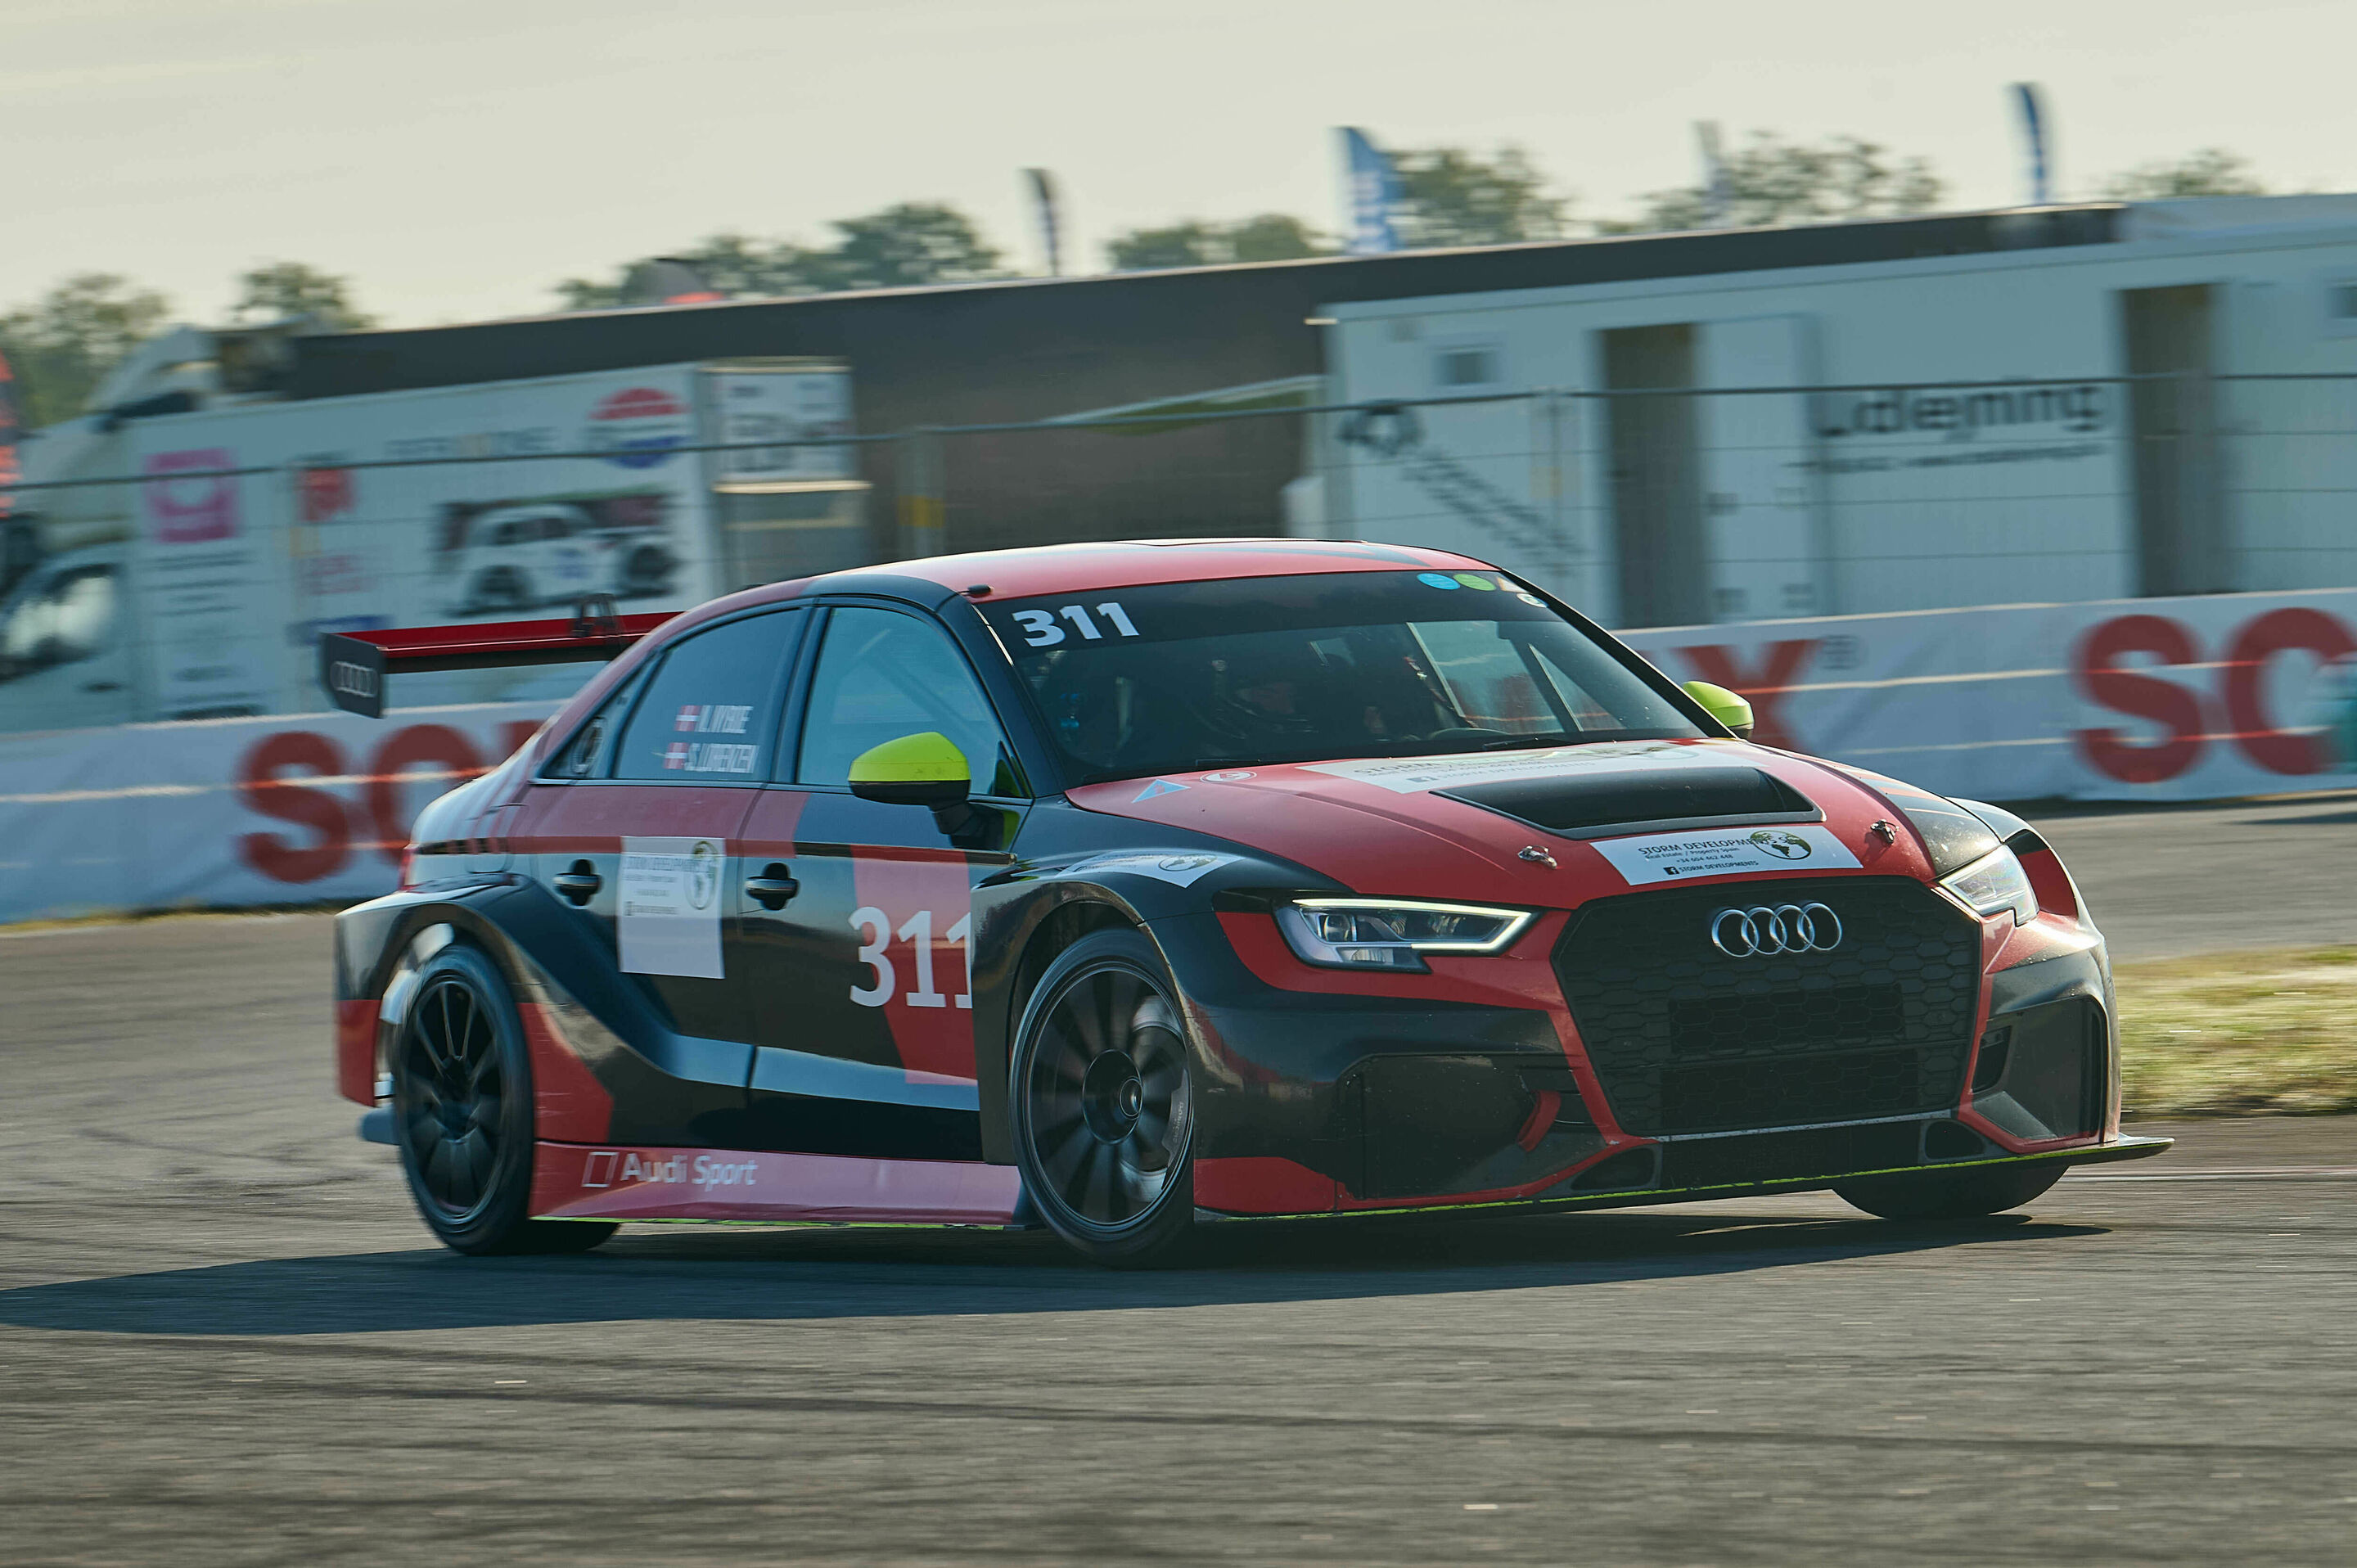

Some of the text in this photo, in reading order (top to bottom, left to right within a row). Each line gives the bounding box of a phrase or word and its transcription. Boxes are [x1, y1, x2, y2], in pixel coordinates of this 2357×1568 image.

[1012, 602, 1140, 647] 311
[1638, 845, 1683, 855] STORM
[1705, 860, 1759, 870] DEVELOPMENTS
[848, 906, 972, 1009] 311
[620, 1153, 759, 1192] Audi Sport
